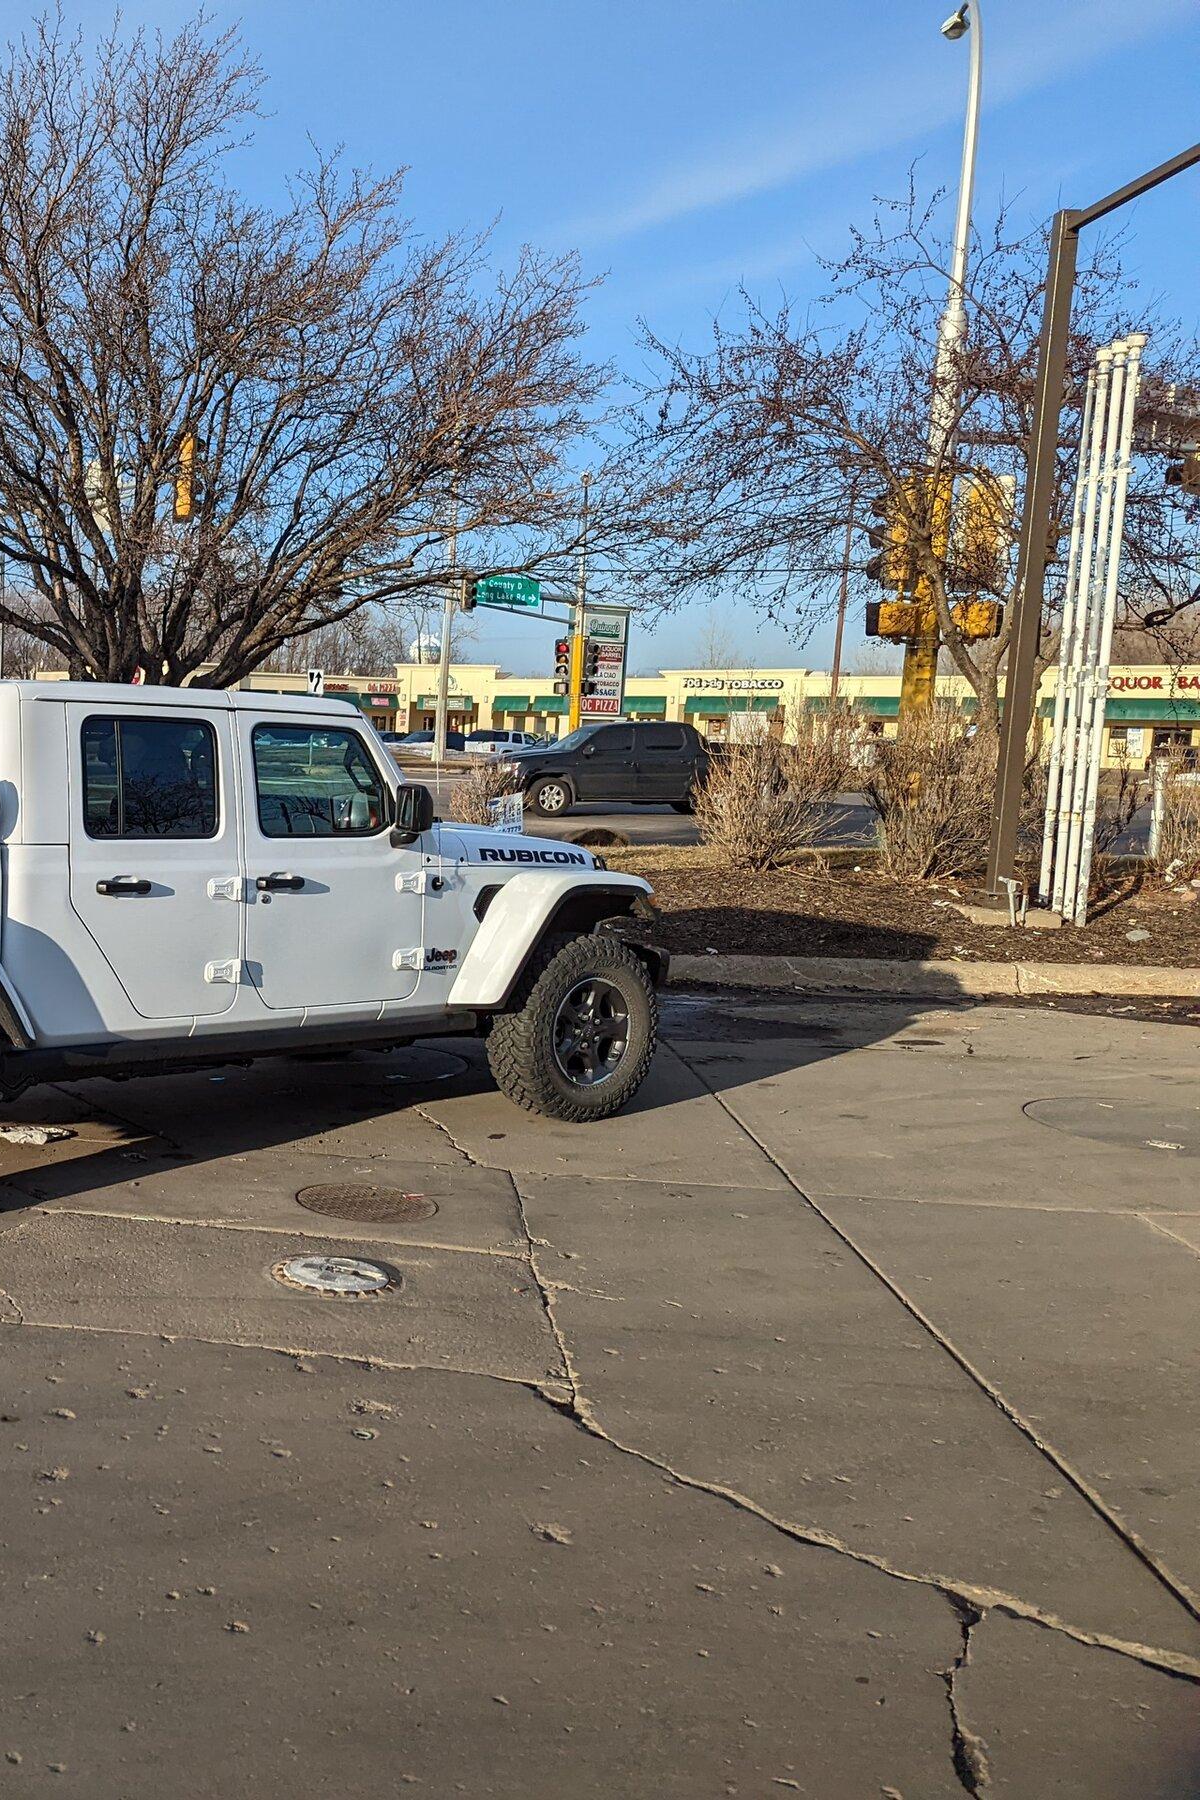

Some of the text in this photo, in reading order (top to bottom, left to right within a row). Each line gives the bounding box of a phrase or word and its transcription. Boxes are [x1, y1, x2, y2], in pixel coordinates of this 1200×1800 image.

[488, 580, 514, 590] County
[477, 592, 494, 600] Long
[496, 592, 513, 600] Lake
[725, 680, 783, 690] TOBACCO
[1108, 676, 1164, 692] QUOR
[595, 700, 618, 712] PIZZA
[479, 848, 586, 865] RUBICON
[426, 947, 457, 963] Jeep
